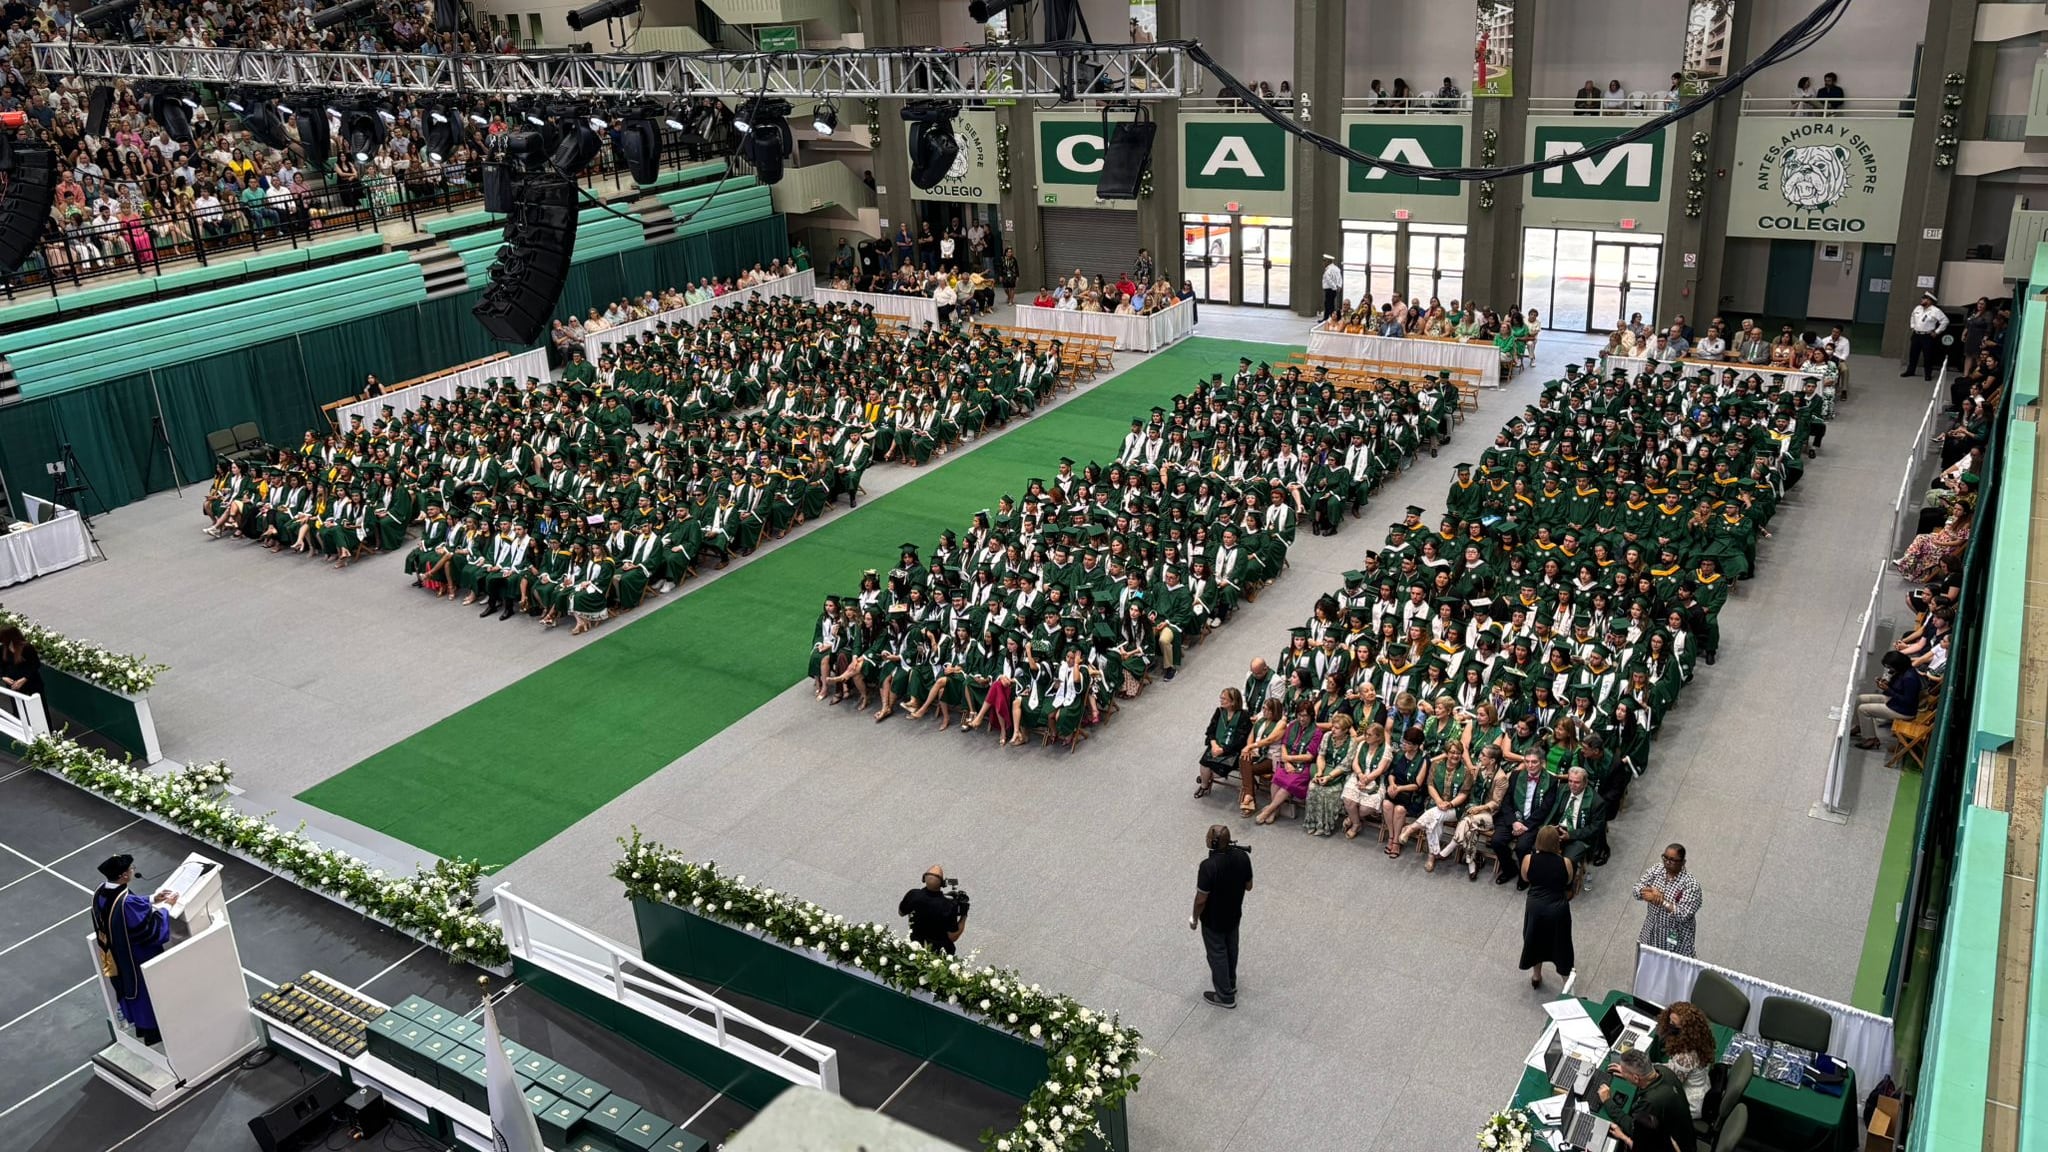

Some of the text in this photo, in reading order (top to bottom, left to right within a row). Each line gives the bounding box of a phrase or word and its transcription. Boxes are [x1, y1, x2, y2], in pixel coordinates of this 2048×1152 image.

[964, 122, 984, 168] SIEMPRE
[1056, 134, 1653, 187] C A A M
[1840, 127, 1850, 138] Y
[1849, 134, 1877, 194] SIEMPRE
[1758, 216, 1866, 232] COLEGIO
[1927, 229, 1940, 238] EXIT
